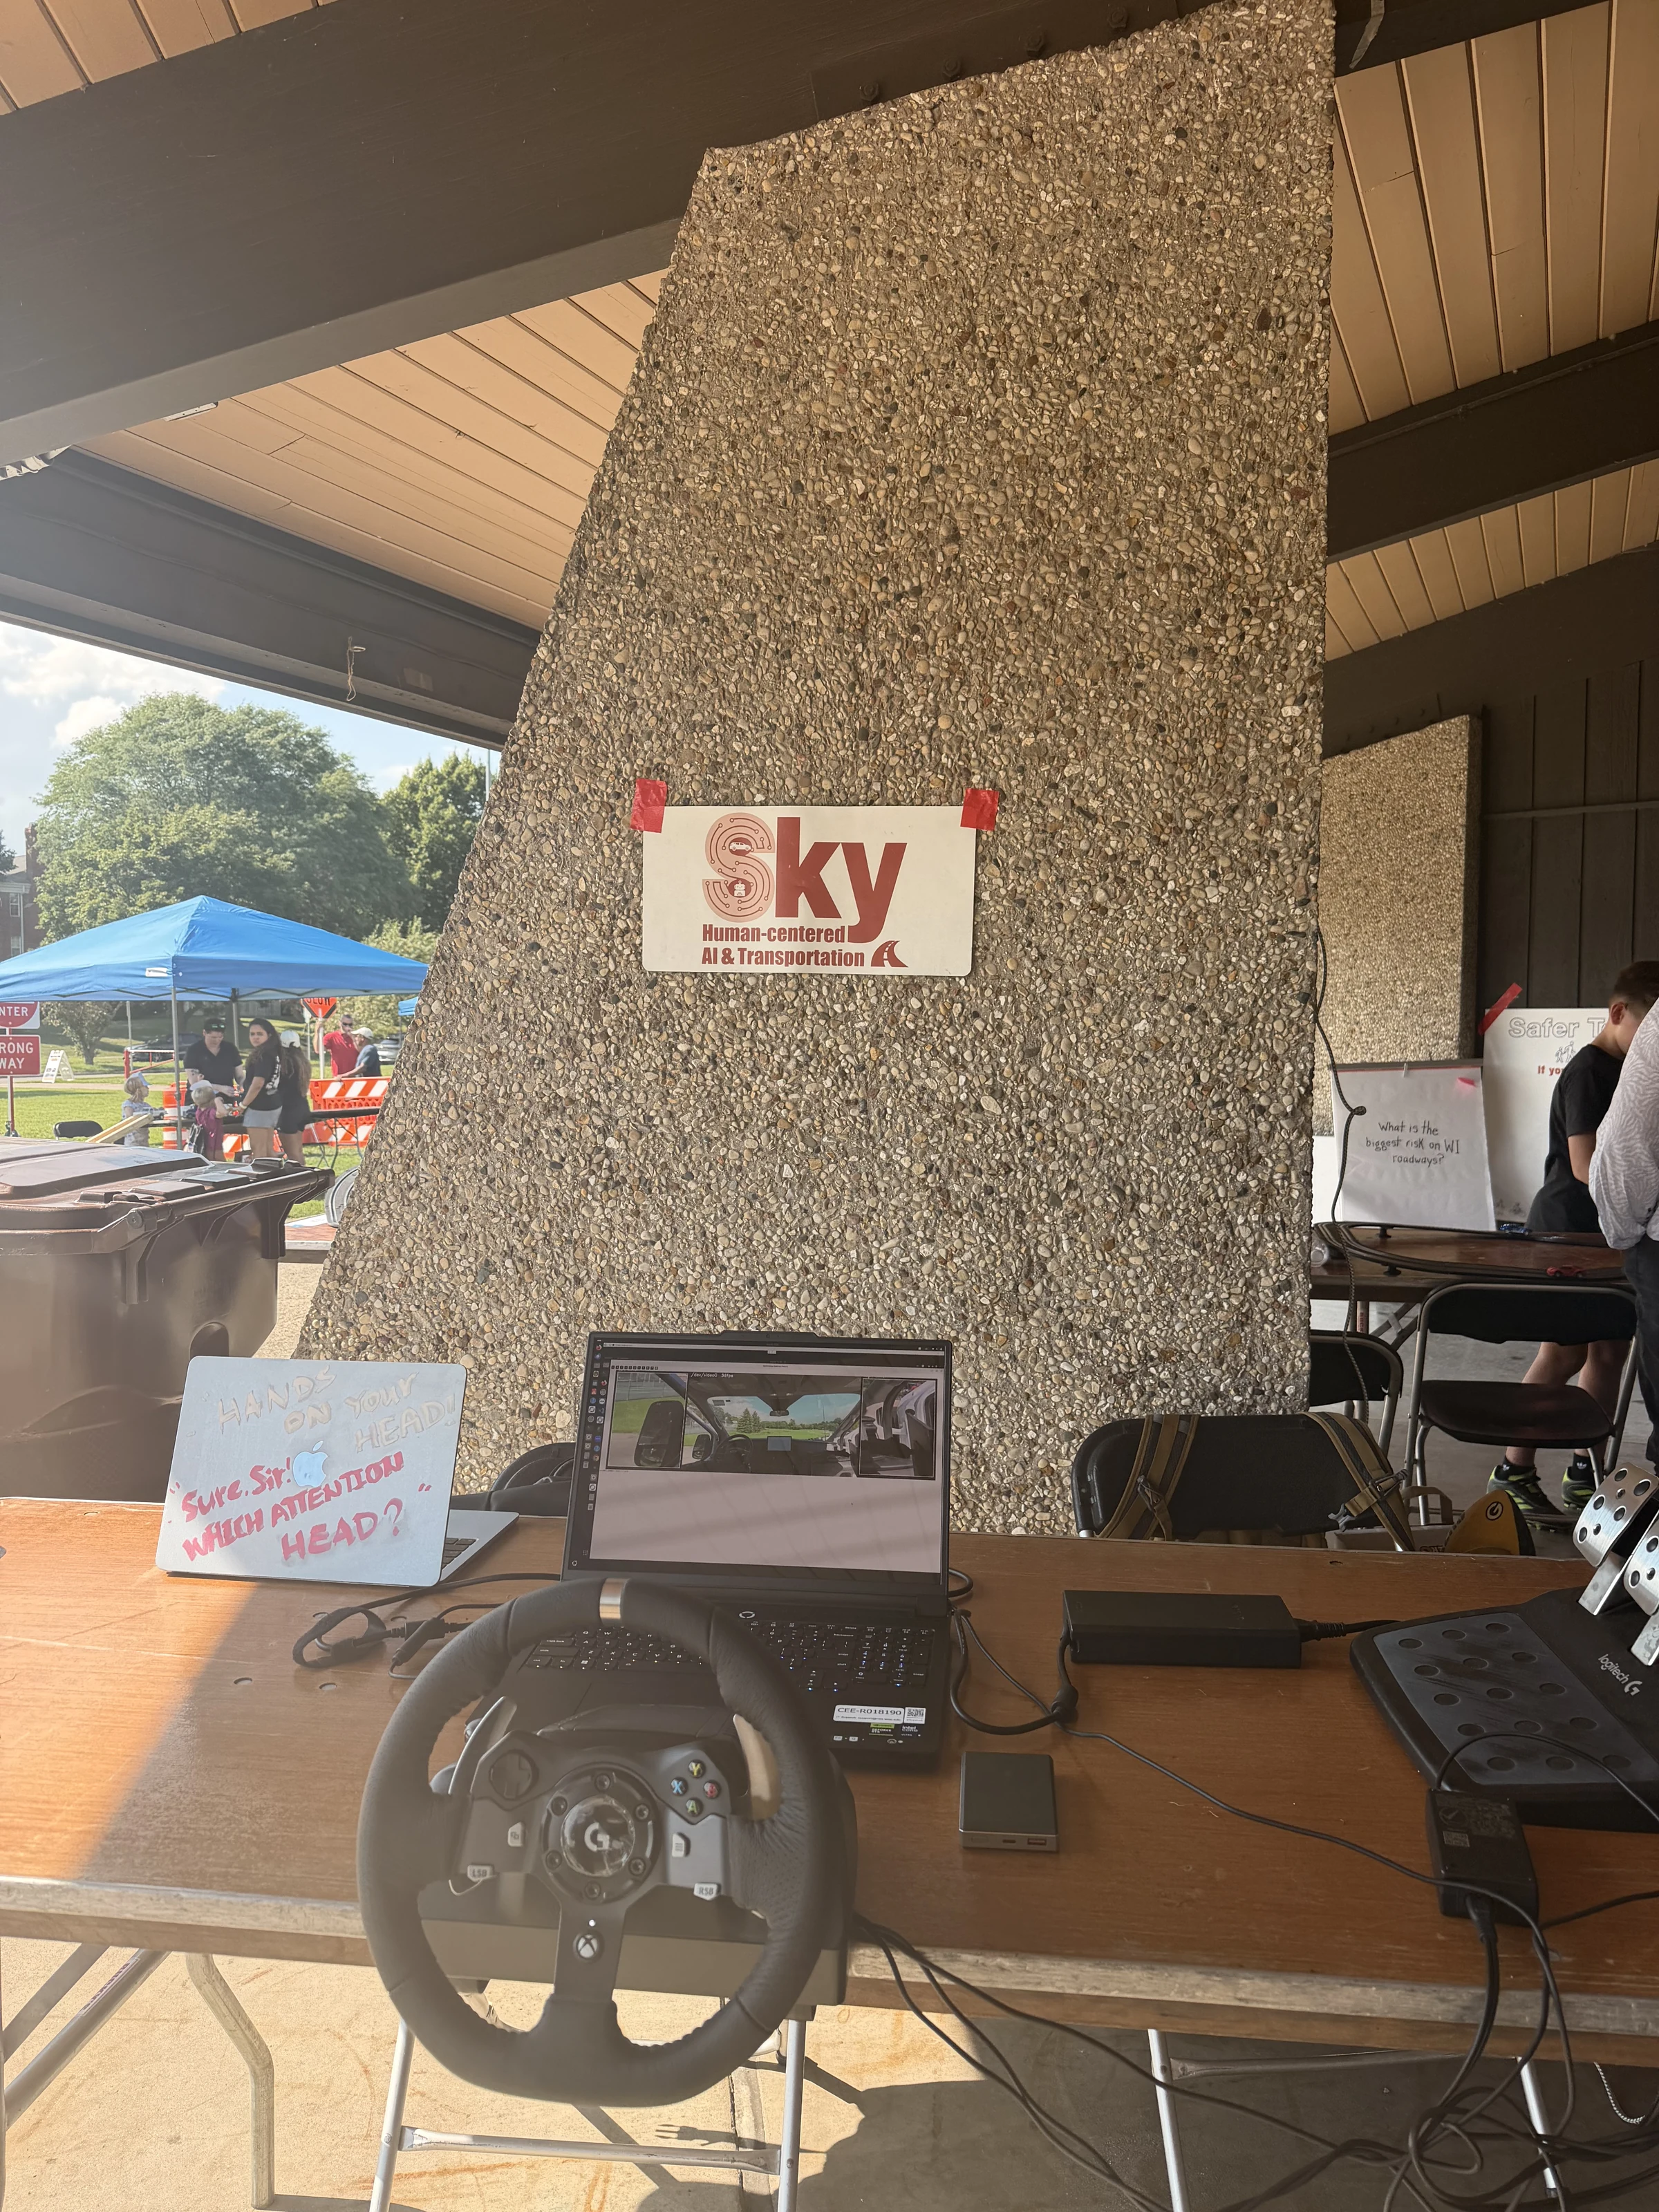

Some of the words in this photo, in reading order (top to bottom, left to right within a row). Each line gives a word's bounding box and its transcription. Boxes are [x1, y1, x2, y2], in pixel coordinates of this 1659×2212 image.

[702, 812, 907, 943] Sky
[702, 924, 845, 943] Human-centered
[702, 948, 718, 964] AI
[721, 948, 735, 965] &
[738, 948, 864, 967] Transportation
[1508, 1017, 1580, 1038] Safer
[1537, 1066, 1546, 1074] If
[1549, 1067, 1564, 1076] yo
[1378, 1121, 1405, 1133] What
[1409, 1125, 1418, 1134] is
[1421, 1120, 1438, 1136] the
[1366, 1136, 1402, 1151] biggest
[1429, 1143, 1441, 1151] on
[1444, 1139, 1460, 1154] WI
[1393, 1153, 1444, 1168] roadways?
[284, 1401, 332, 1434] ON
[355, 1394, 456, 1453] HEAD!
[182, 1508, 264, 1562] WHICH
[271, 1451, 404, 1528] ATTENTION
[1598, 1653, 1629, 1684] logitech
[692, 1763, 701, 1776] Y
[673, 1779, 682, 1794] X
[688, 1799, 697, 1814] A
